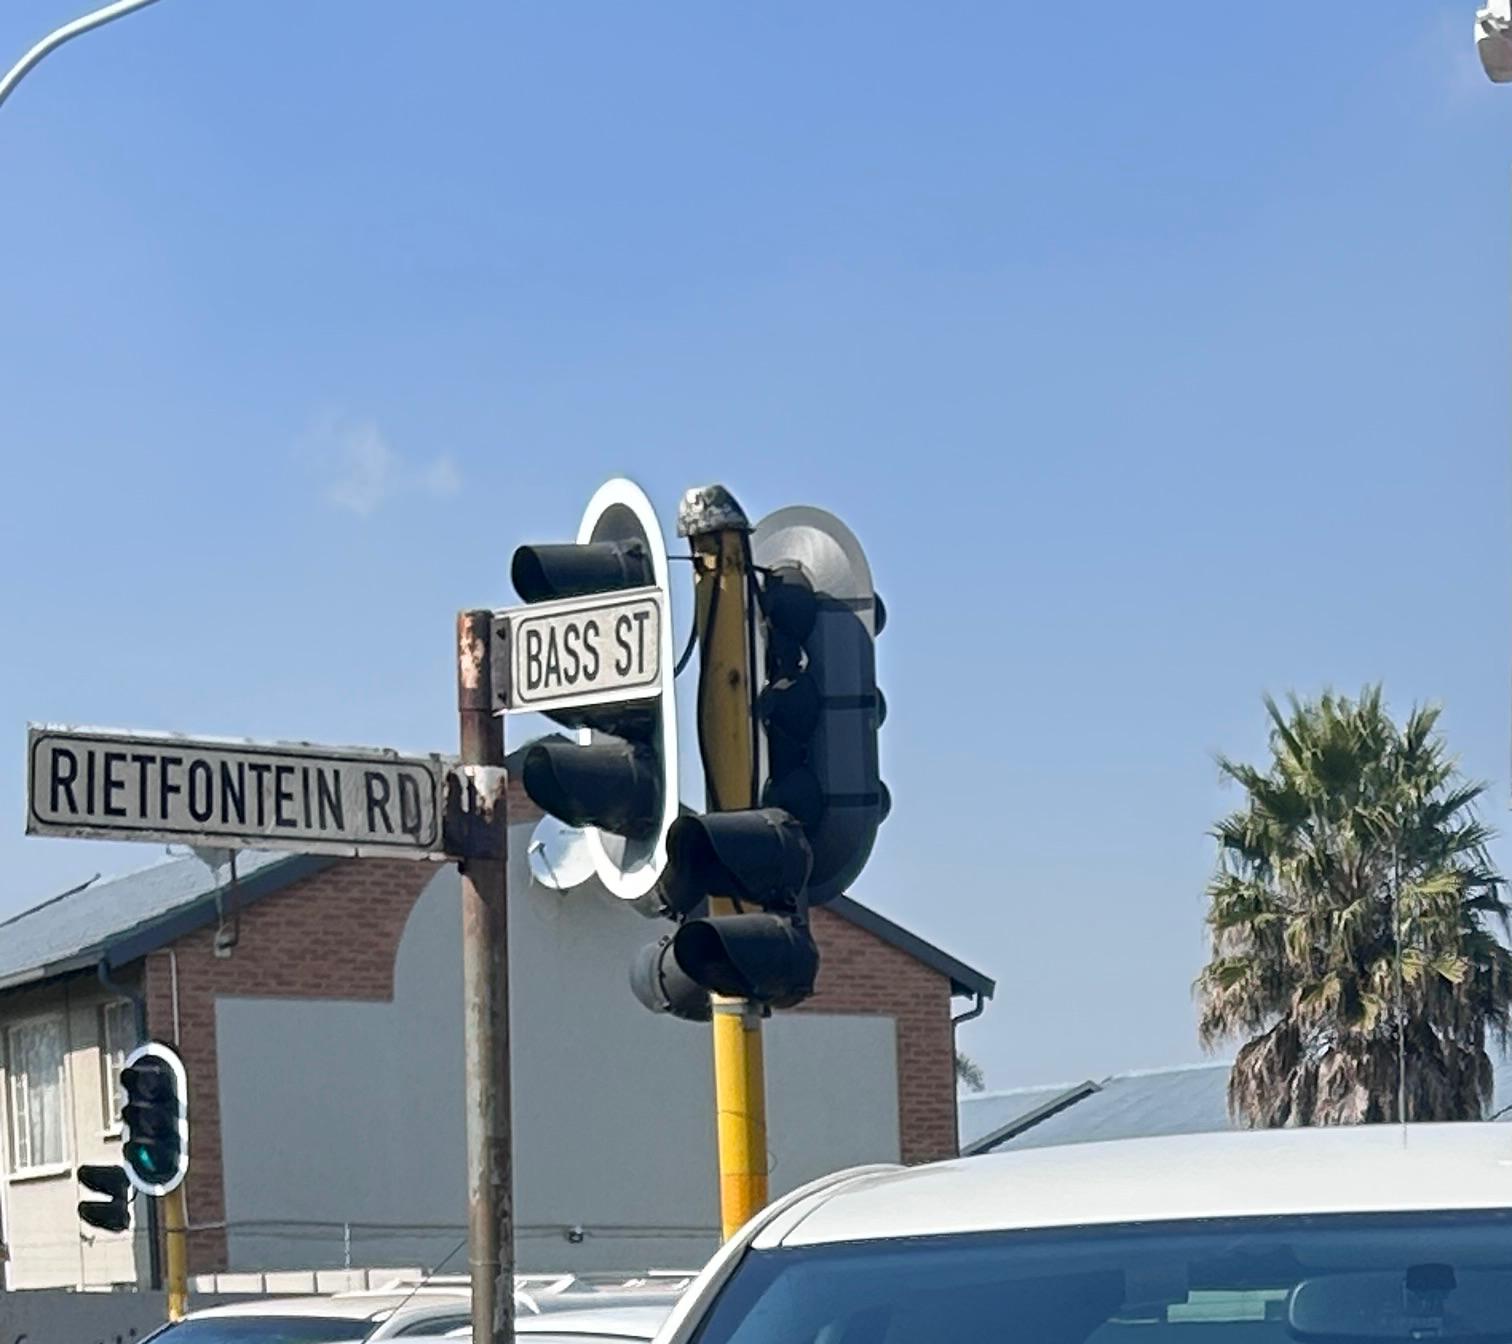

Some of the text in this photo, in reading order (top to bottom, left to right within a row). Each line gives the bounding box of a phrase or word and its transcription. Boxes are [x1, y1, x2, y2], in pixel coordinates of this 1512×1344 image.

[526, 609, 651, 692] BASS ST
[48, 746, 423, 837] RIETFONTEIN RD
